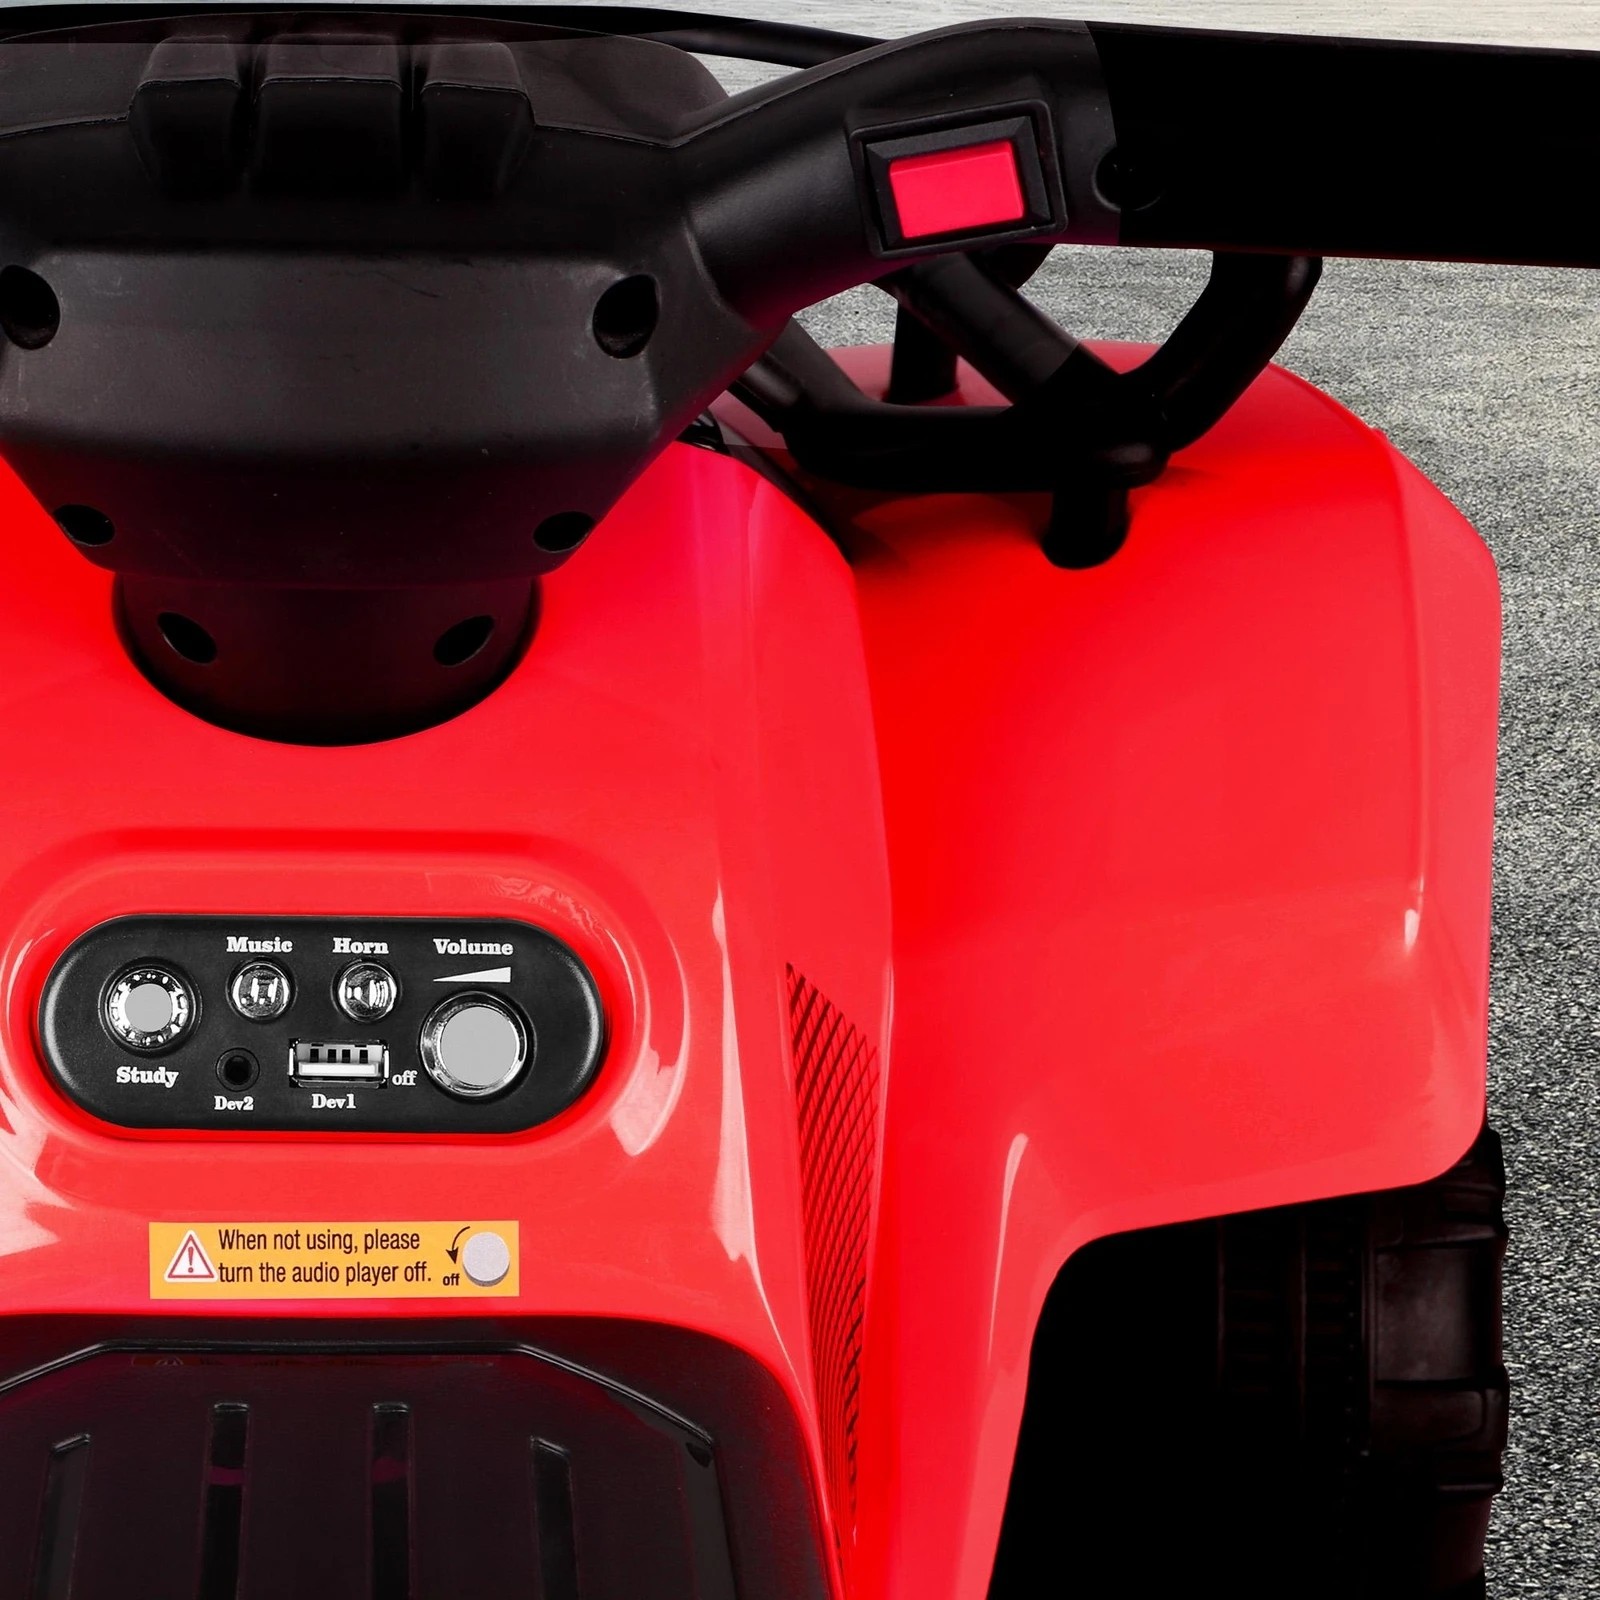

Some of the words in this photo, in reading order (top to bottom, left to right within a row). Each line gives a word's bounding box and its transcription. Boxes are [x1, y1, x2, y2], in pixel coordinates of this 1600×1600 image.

[227, 937, 292, 952] Music
[333, 938, 389, 954] Horn
[433, 939, 513, 955] Volume
[117, 1066, 179, 1088] Study
[392, 1070, 417, 1085] off
[214, 1096, 253, 1110] Dev2
[312, 1094, 356, 1108] Dev1
[219, 1229, 266, 1250] When
[274, 1230, 300, 1250] not
[307, 1229, 357, 1254] using,
[365, 1229, 419, 1254] please
[218, 1263, 252, 1282] turn
[259, 1262, 285, 1282] the
[293, 1262, 339, 1282] audio
[346, 1262, 399, 1286] player
[404, 1261, 431, 1282] off.
[443, 1273, 460, 1286] off
